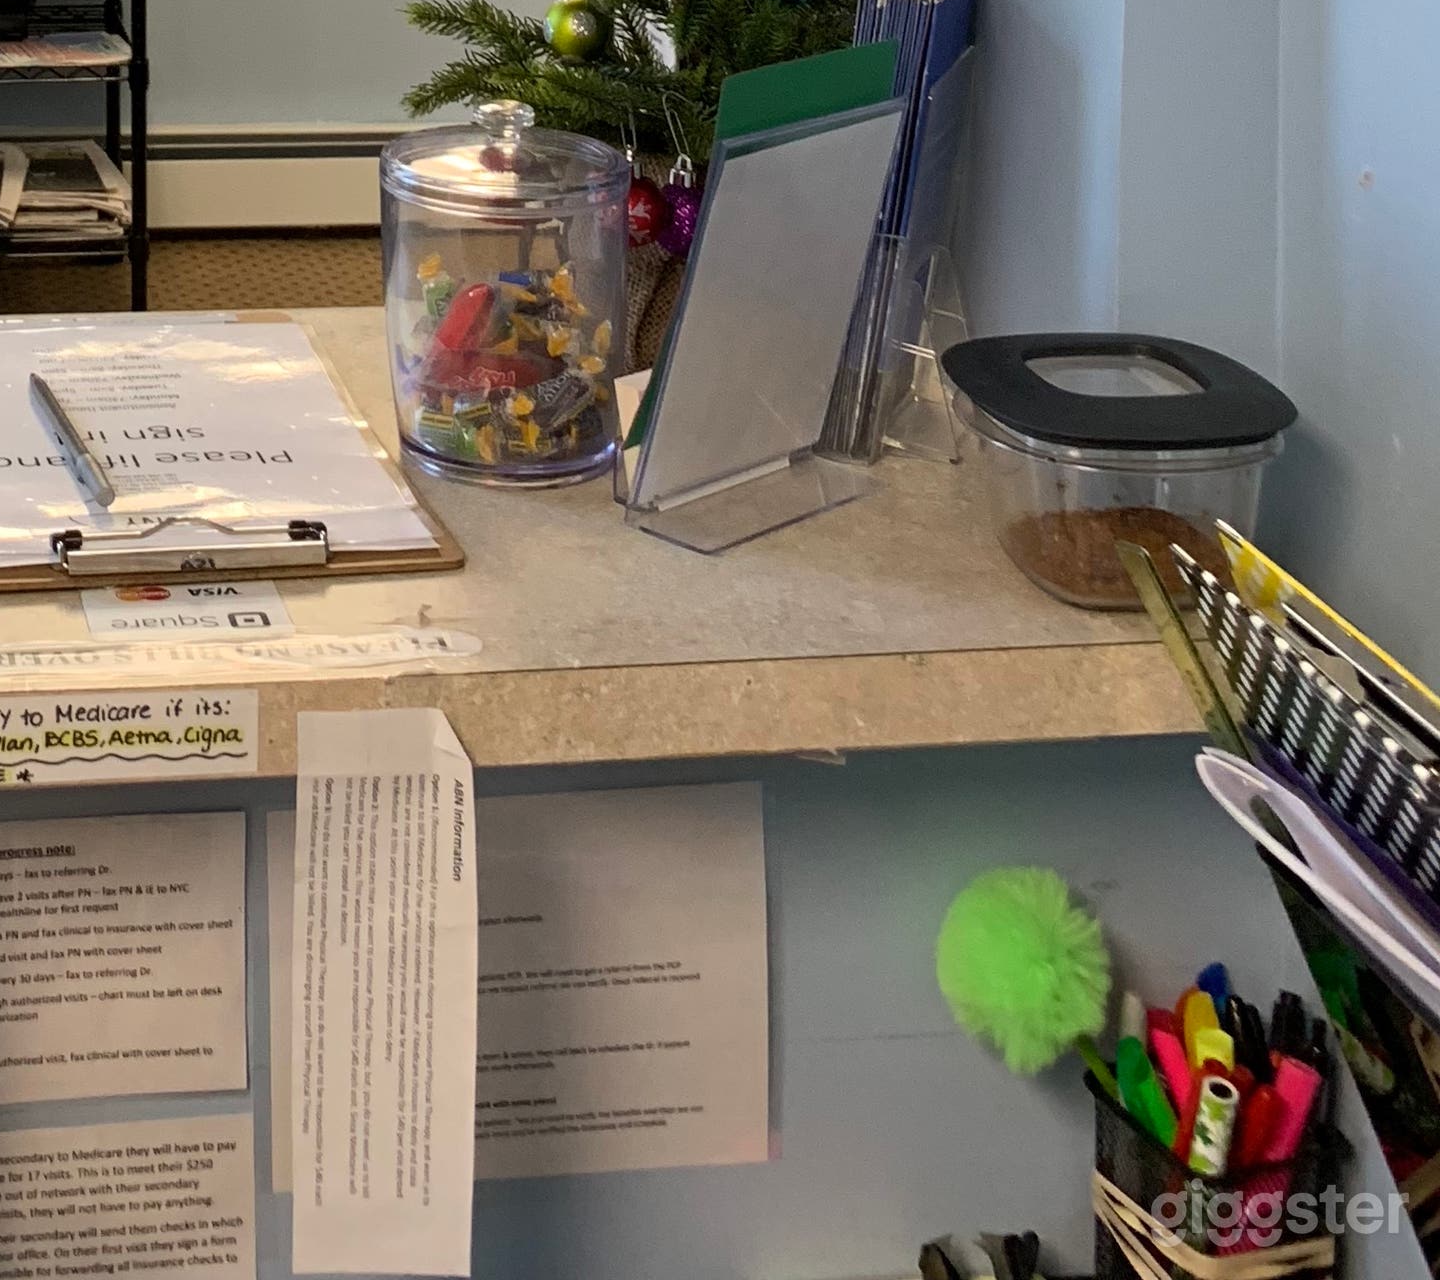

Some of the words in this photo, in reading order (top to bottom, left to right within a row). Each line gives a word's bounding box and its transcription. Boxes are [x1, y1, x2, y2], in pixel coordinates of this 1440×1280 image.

[123, 425, 206, 441] sign
[156, 449, 294, 465] Please
[188, 587, 240, 597] VISA
[111, 614, 220, 629] Square
[20, 707, 44, 728] to
[55, 703, 152, 723] Medicare
[165, 698, 184, 718] if
[195, 697, 232, 716] its:
[45, 730, 107, 750] BCBS,
[184, 726, 242, 753] Cigna
[454, 778, 464, 806] ABN
[453, 808, 465, 882] Information
